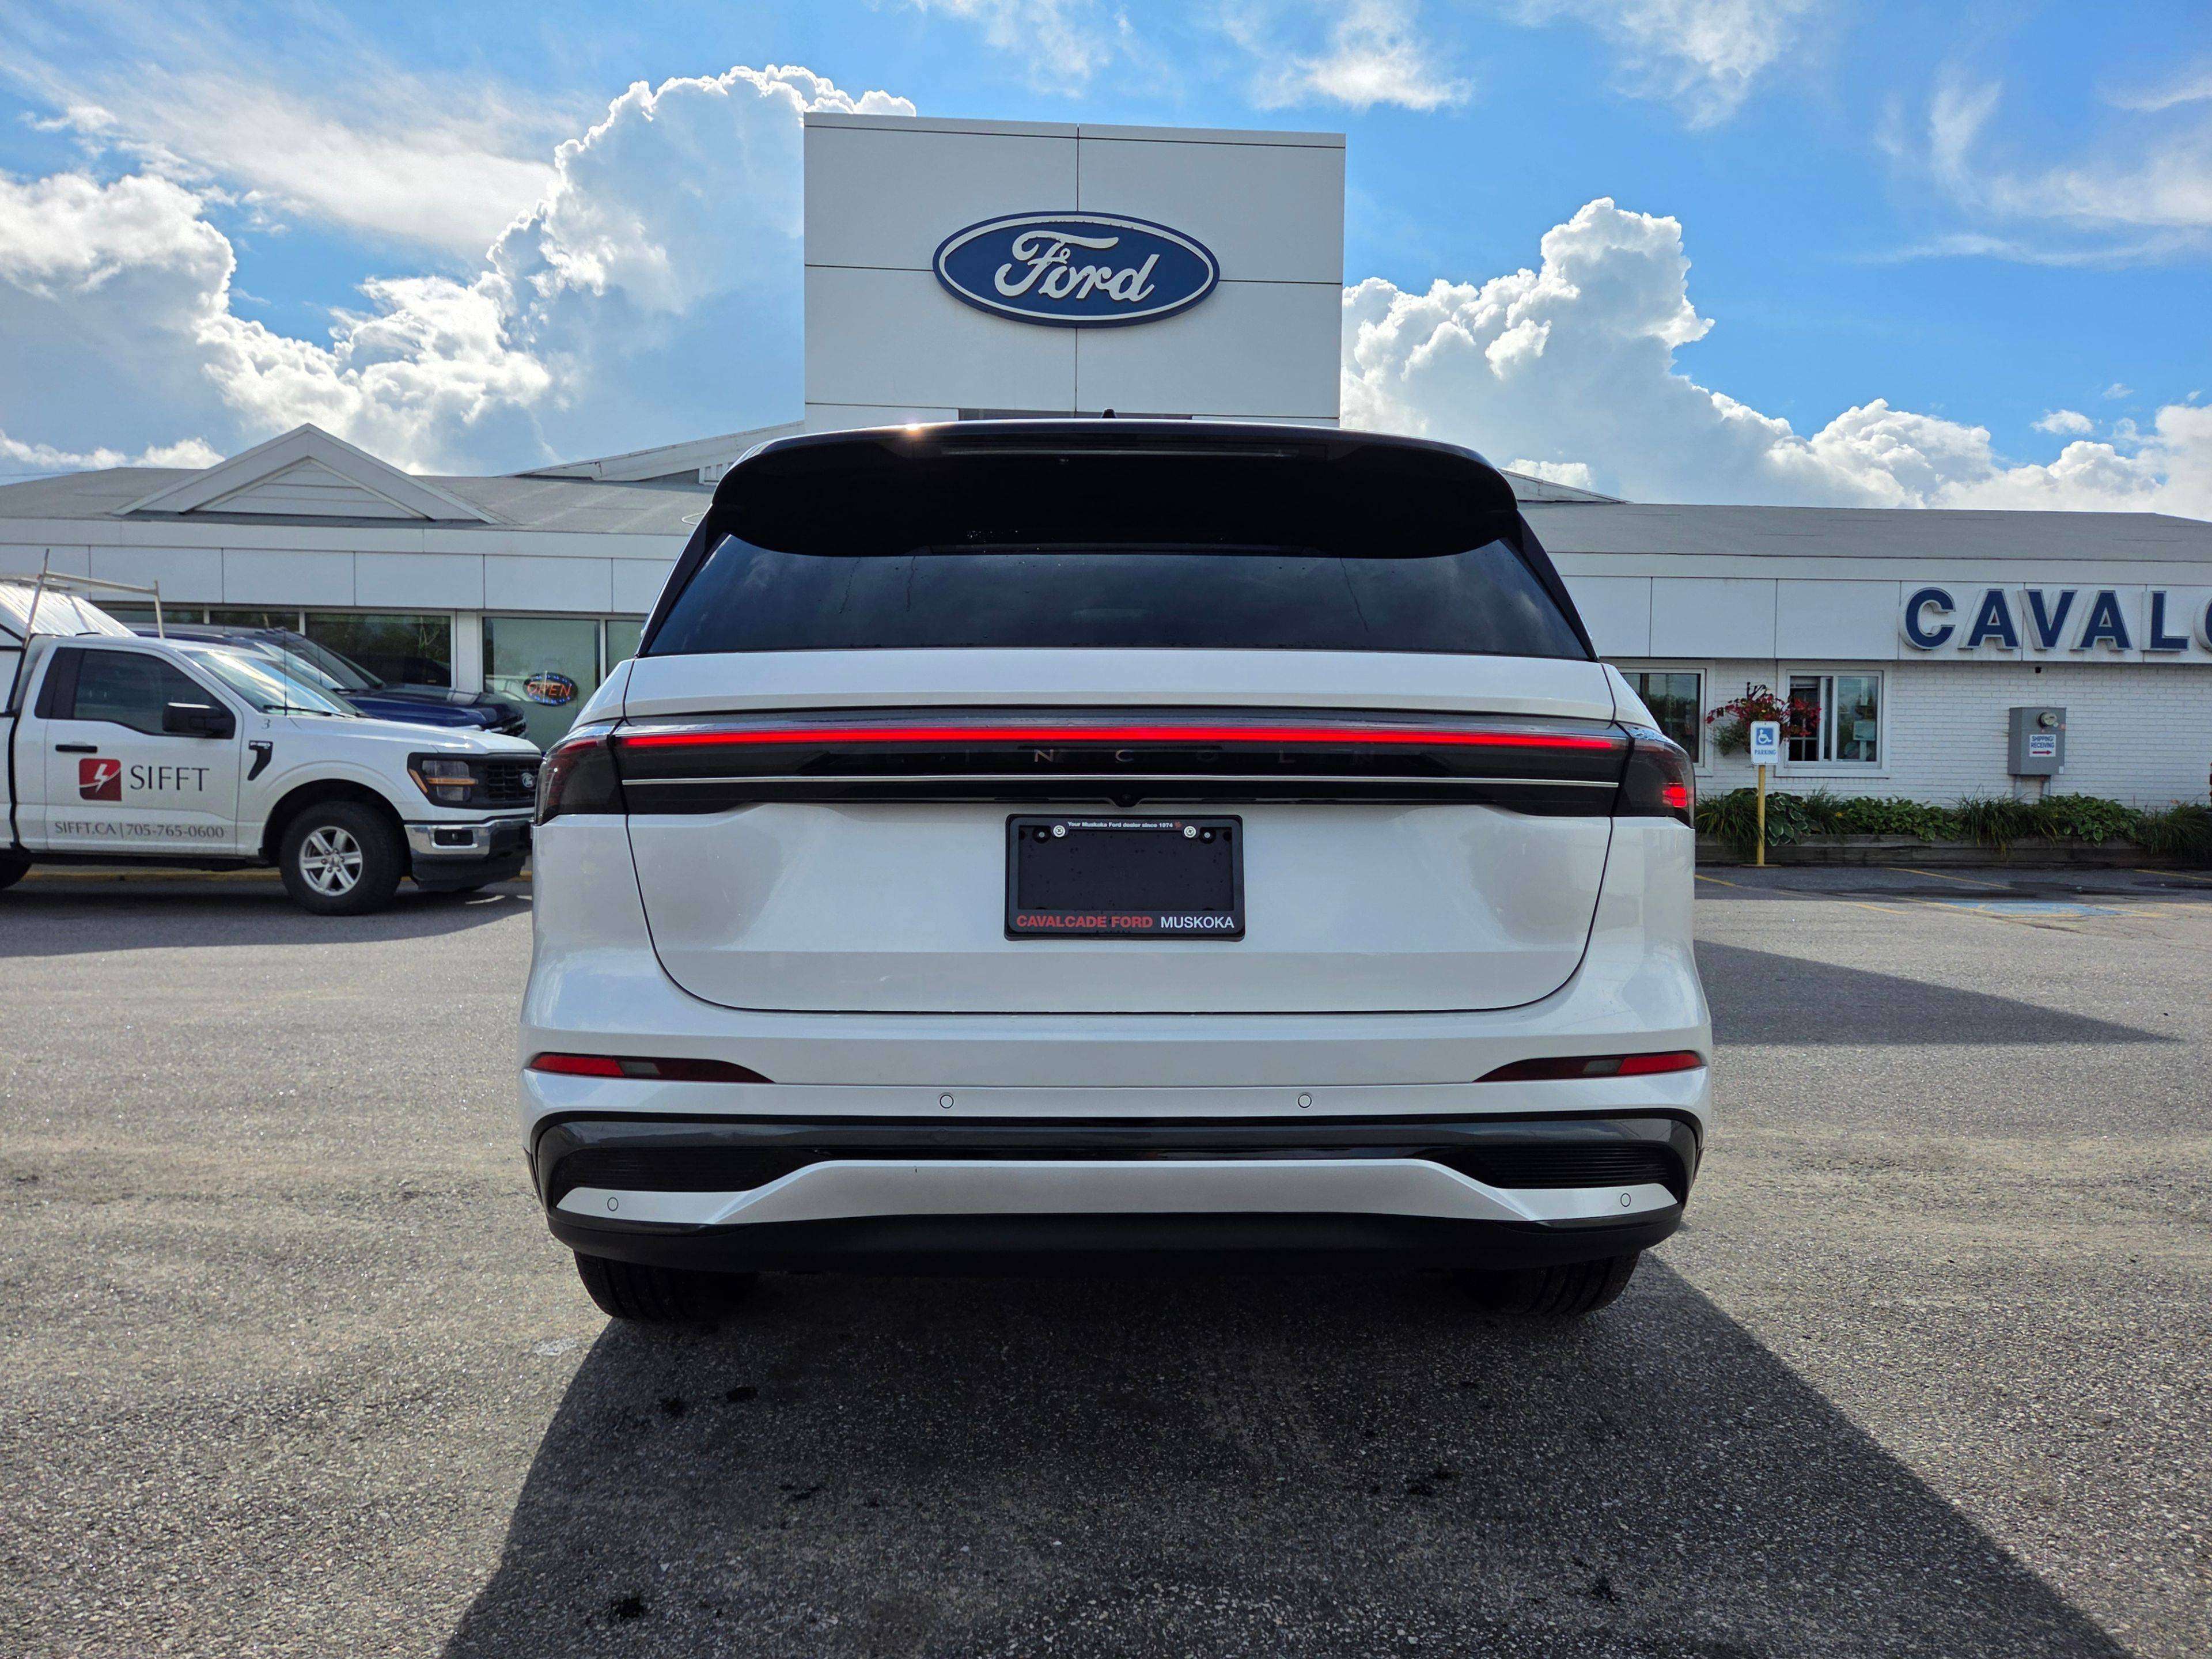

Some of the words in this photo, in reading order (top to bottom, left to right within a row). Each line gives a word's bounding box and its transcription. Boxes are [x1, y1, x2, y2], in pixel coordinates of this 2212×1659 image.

[994, 230, 1160, 302] Ford
[1900, 586, 2212, 651] CAVAL
[527, 681, 572, 696] OPEN
[130, 765, 210, 791] SIFFT
[55, 821, 116, 835] SIFFT.CA
[126, 824, 224, 838] 705-765-0600
[1016, 915, 1107, 927] CAVALCADE
[1111, 916, 1153, 927] FORD
[1161, 916, 1234, 929] MUSKOKA
